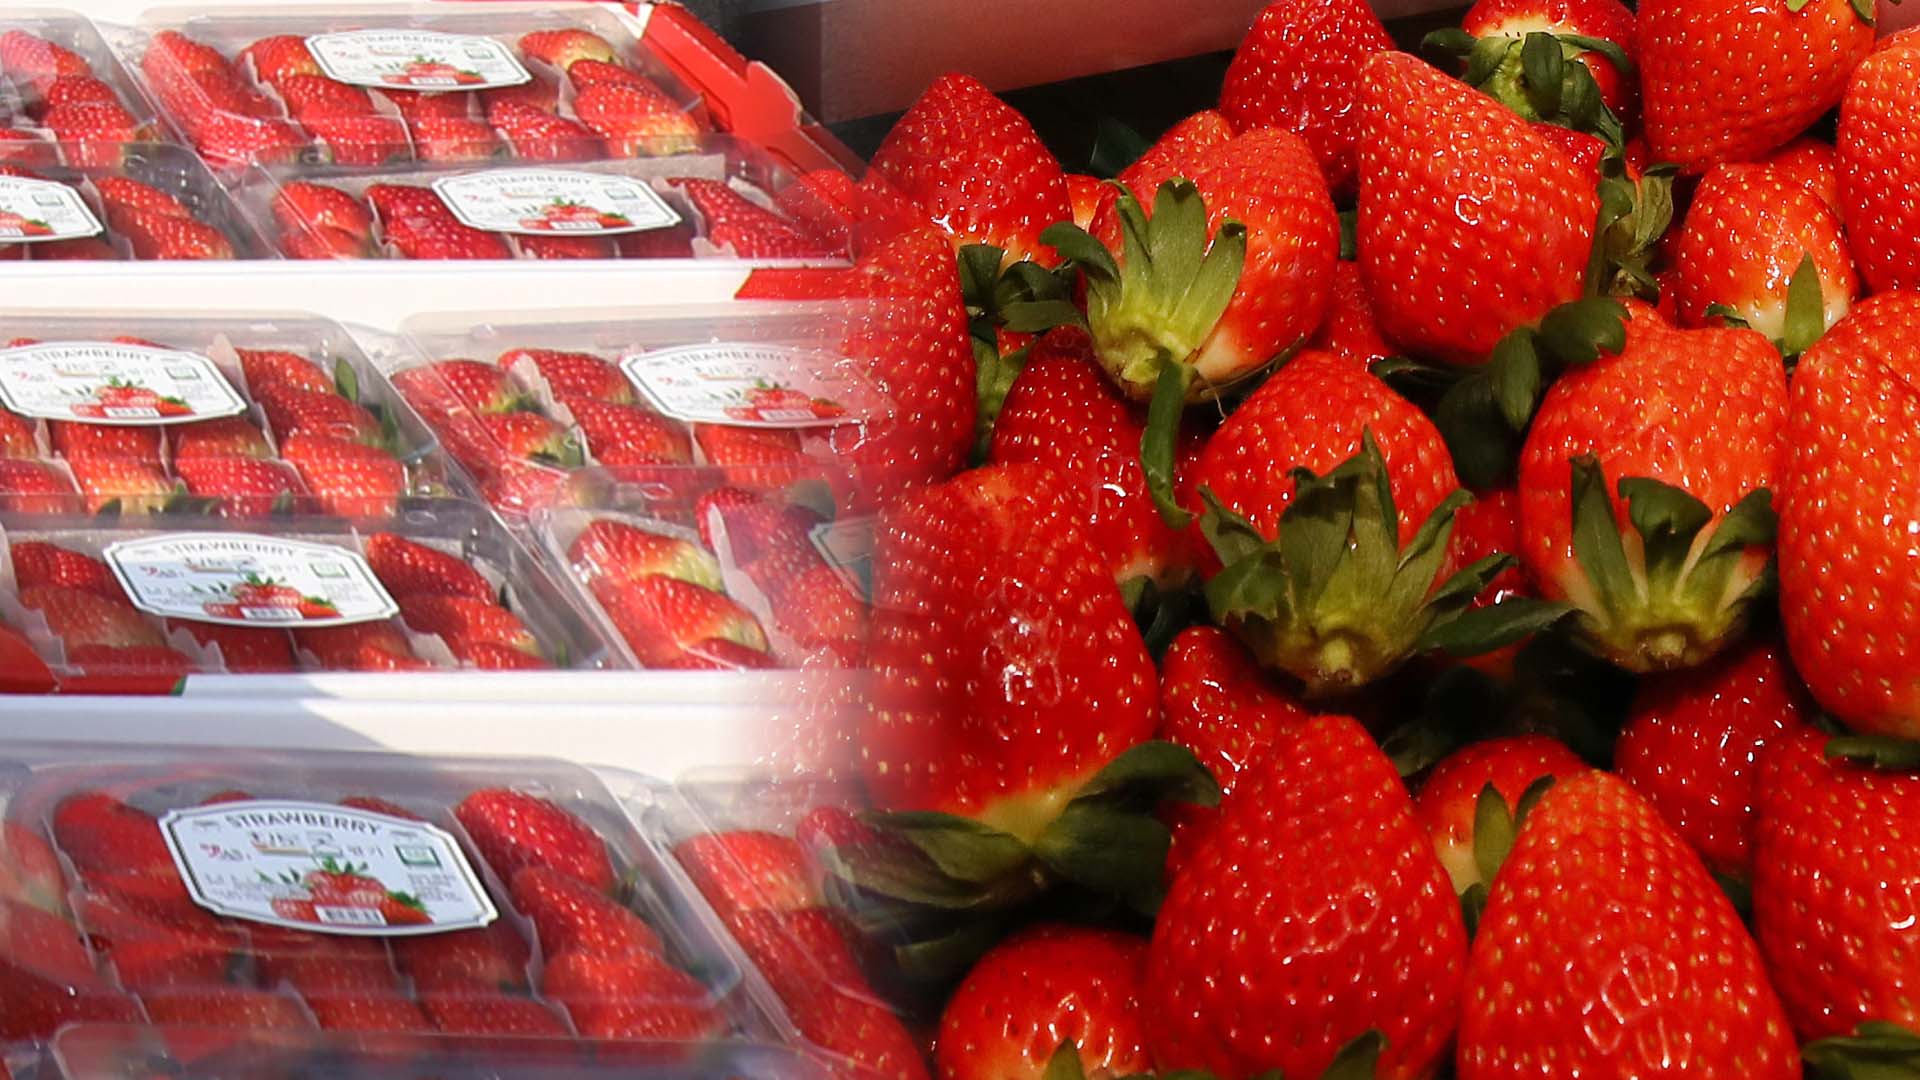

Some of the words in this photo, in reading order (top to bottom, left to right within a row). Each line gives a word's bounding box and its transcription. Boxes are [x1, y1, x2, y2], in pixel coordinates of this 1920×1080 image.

[479, 174, 593, 186] STRAWBERRY
[31, 347, 153, 362] STRAWBERRY
[671, 350, 792, 363] STRAWBERRY
[162, 541, 297, 557] STRAWBERRY
[225, 809, 382, 835] STRAWBERRY
